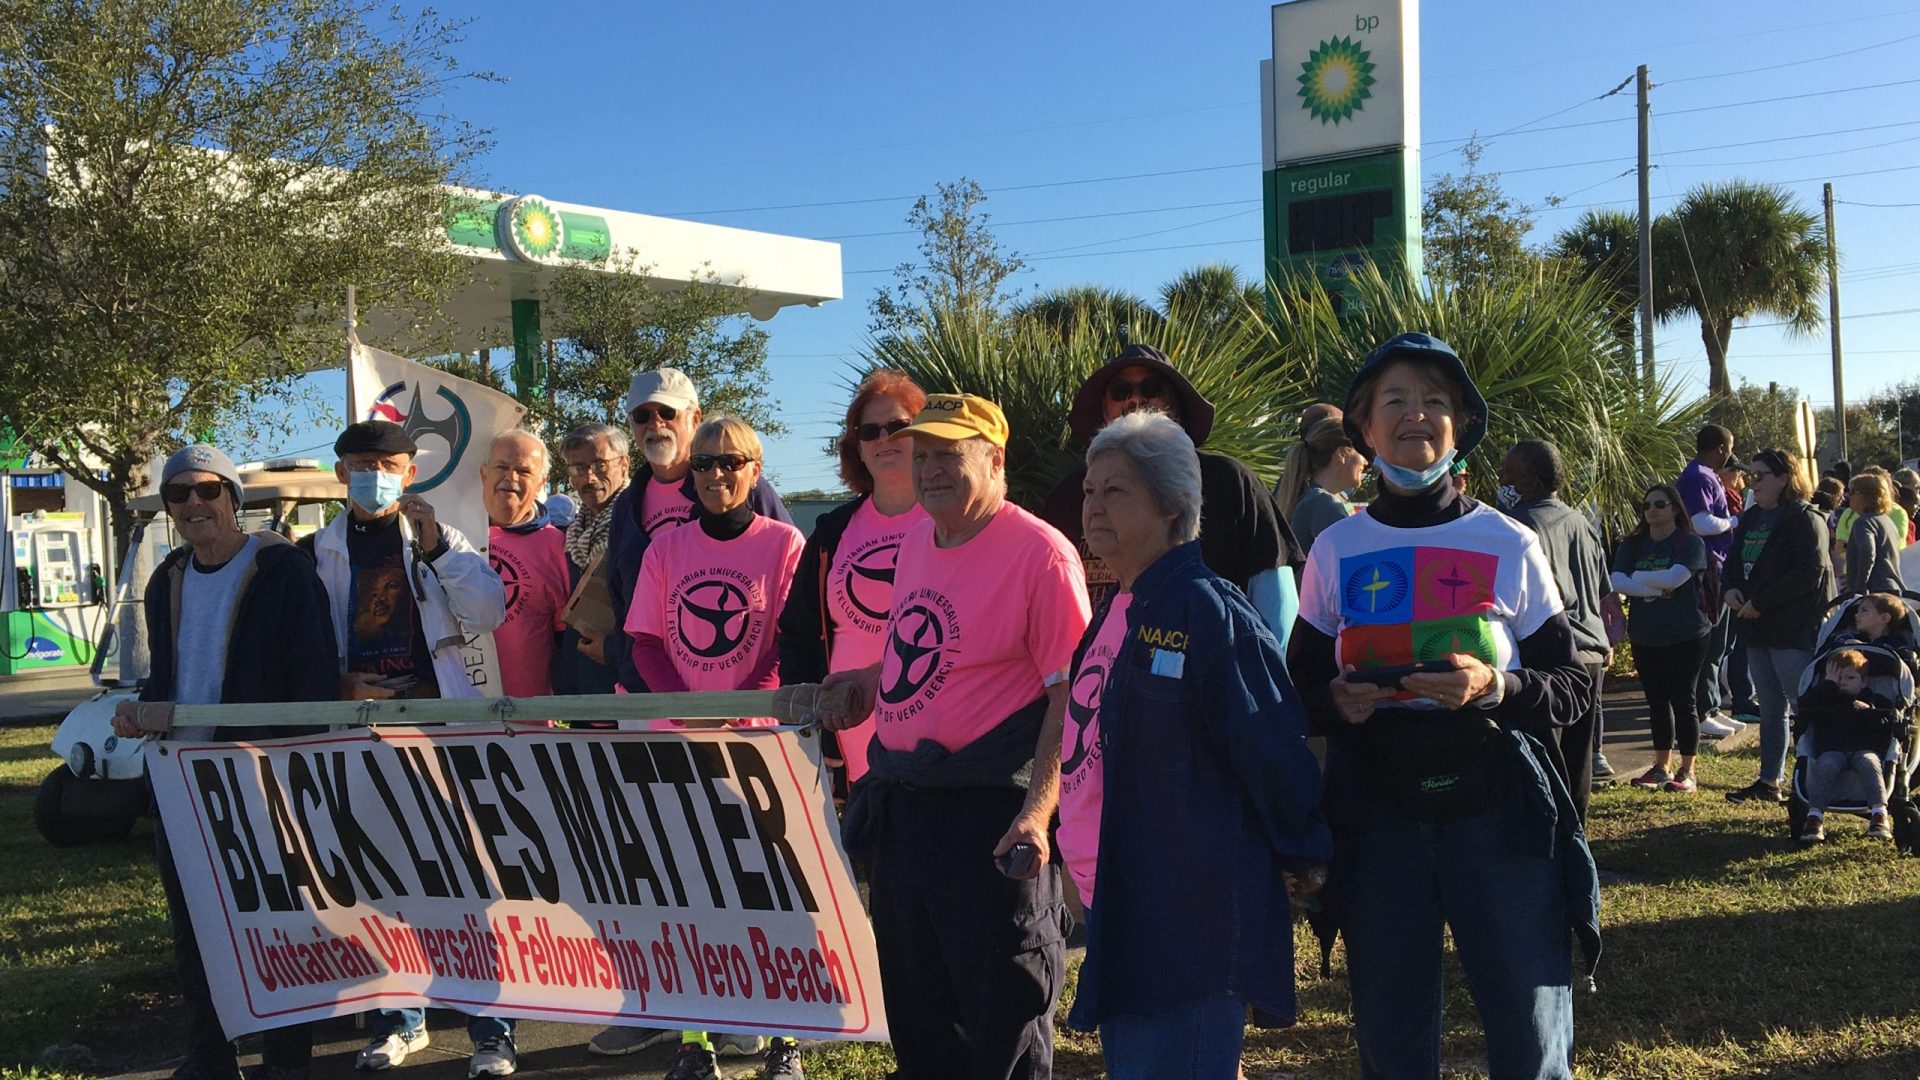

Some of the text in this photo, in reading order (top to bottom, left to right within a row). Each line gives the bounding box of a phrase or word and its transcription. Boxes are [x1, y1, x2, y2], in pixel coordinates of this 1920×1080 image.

[1355, 14, 1379, 33] bp
[1291, 171, 1350, 194] regular
[837, 539, 878, 575] UNITARIAN
[668, 567, 763, 605] UNITARIAN UNIVERSALIST
[836, 590, 882, 634] FELLOWSHIP
[702, 662, 715, 672] OF
[718, 652, 744, 670] VERO
[743, 620, 763, 654] BEACH
[884, 711, 894, 723] OF
[897, 699, 924, 722] VERO
[925, 661, 955, 700] BEACH
[192, 741, 820, 913] BLACK LIVES MATTER
[245, 911, 852, 1012] Unitarian Universalist Fellowship of Vero Beach
